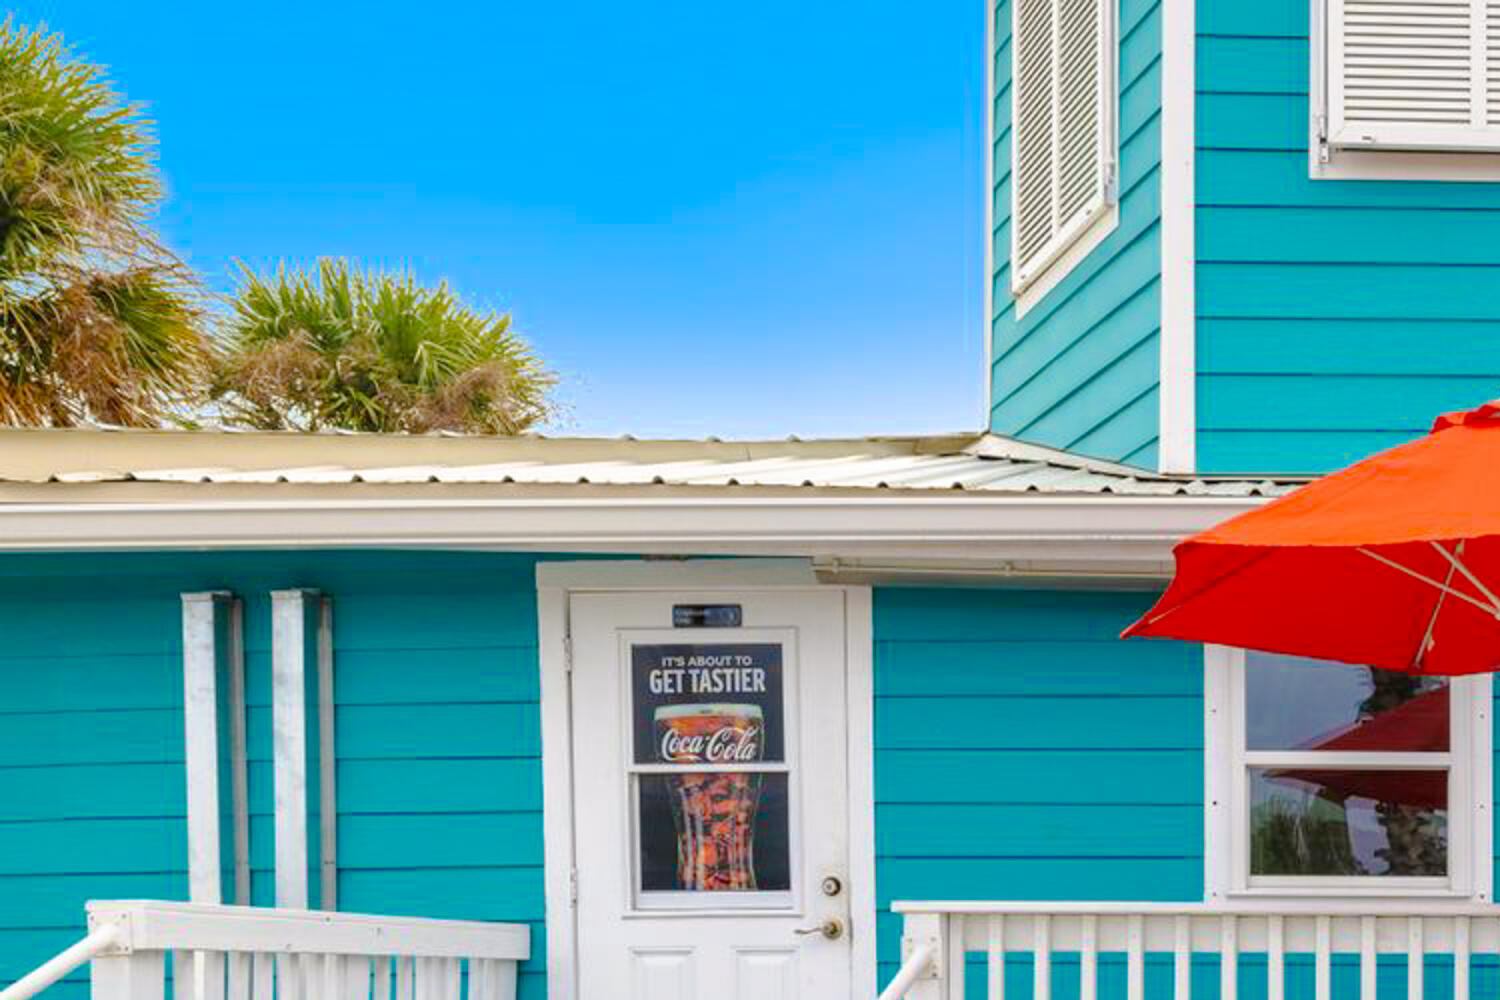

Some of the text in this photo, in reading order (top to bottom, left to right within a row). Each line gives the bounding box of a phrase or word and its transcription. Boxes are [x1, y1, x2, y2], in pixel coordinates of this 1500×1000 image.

[661, 655, 753, 667] IT'S ABOUT TO
[649, 668, 766, 693] GET TASTIER
[661, 725, 760, 762] Coca-Cola
